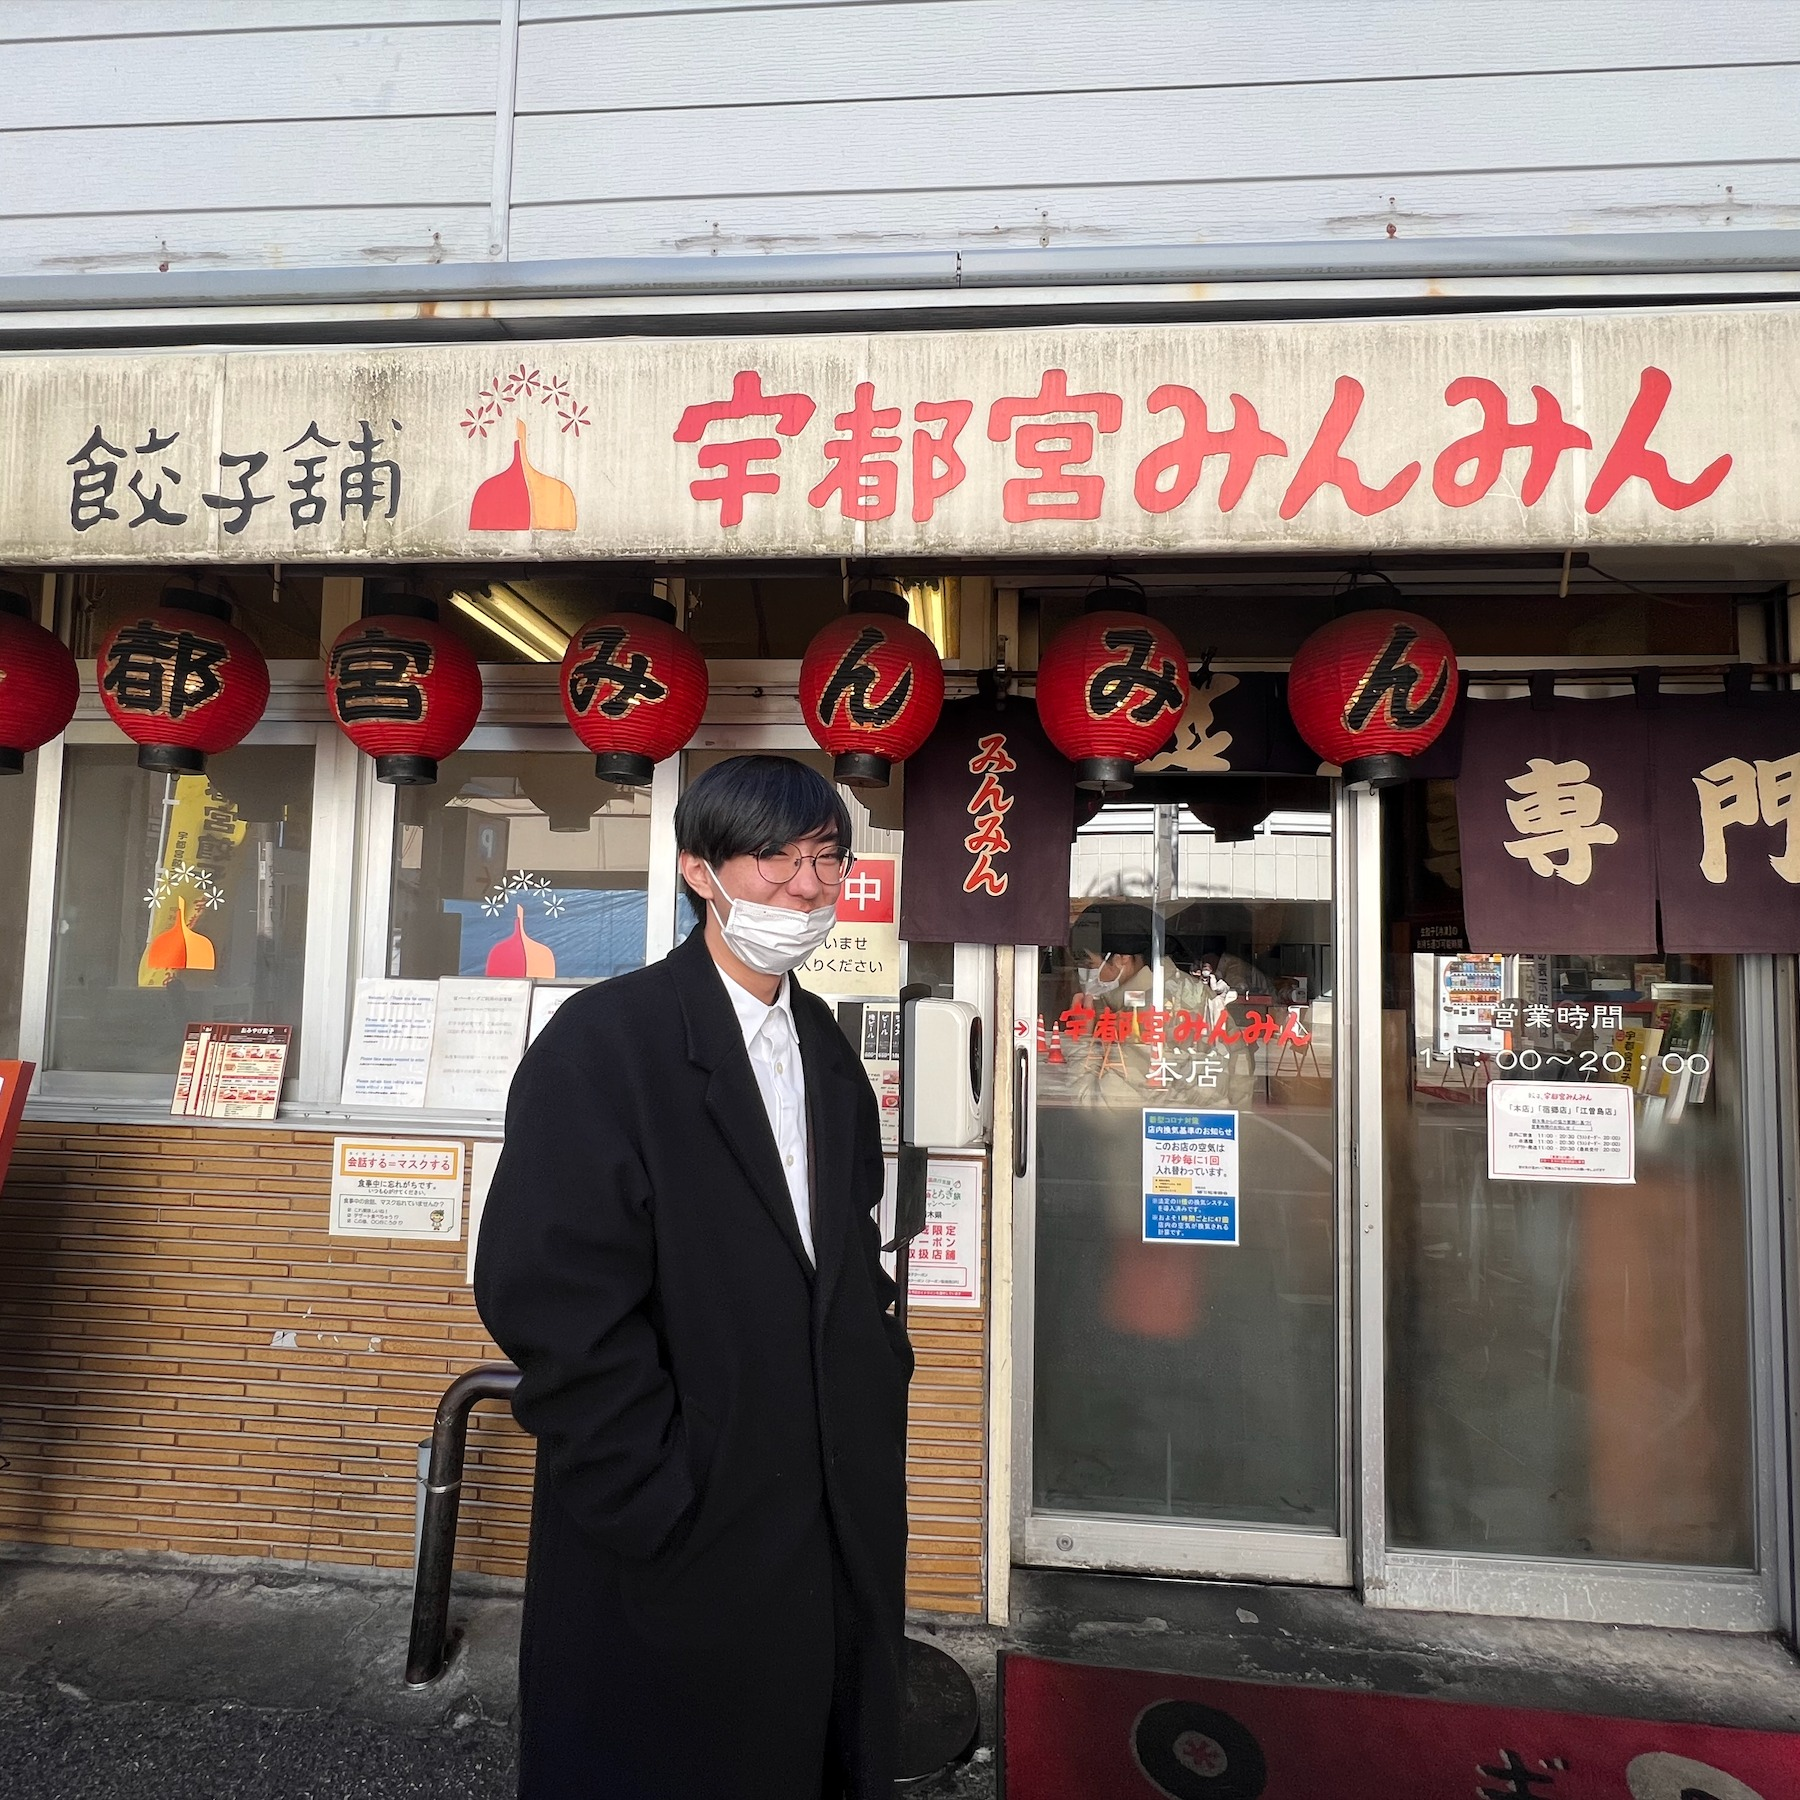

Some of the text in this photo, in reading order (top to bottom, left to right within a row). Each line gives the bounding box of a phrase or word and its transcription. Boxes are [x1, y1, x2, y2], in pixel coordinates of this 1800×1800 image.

[67, 419, 402, 534] 餃子舗
[673, 366, 1733, 527] 宇都宮みんみん
[102, 619, 231, 721] 都
[329, 627, 435, 724] 宮
[568, 624, 668, 721] み
[819, 626, 913, 733] ん
[1085, 627, 1185, 726] み
[1341, 622, 1450, 735] ん
[964, 733, 1016, 897] みんみん
[1059, 1003, 1313, 1048] 宇都宮みんみん
[1489, 1004, 1625, 1031] 営業時間
[1145, 1057, 1225, 1089] 本店
[1147, 1126, 1232, 1136] 店内換気基準のお知らせ
[1155, 1142, 1225, 1153] このお店の空気は
[1156, 1166, 1227, 1177] 入れ替わっています。
[1160, 1155, 1220, 1165] 77秒毎に1回
[358, 1179, 436, 1190] 食事中に忘れがちです。
